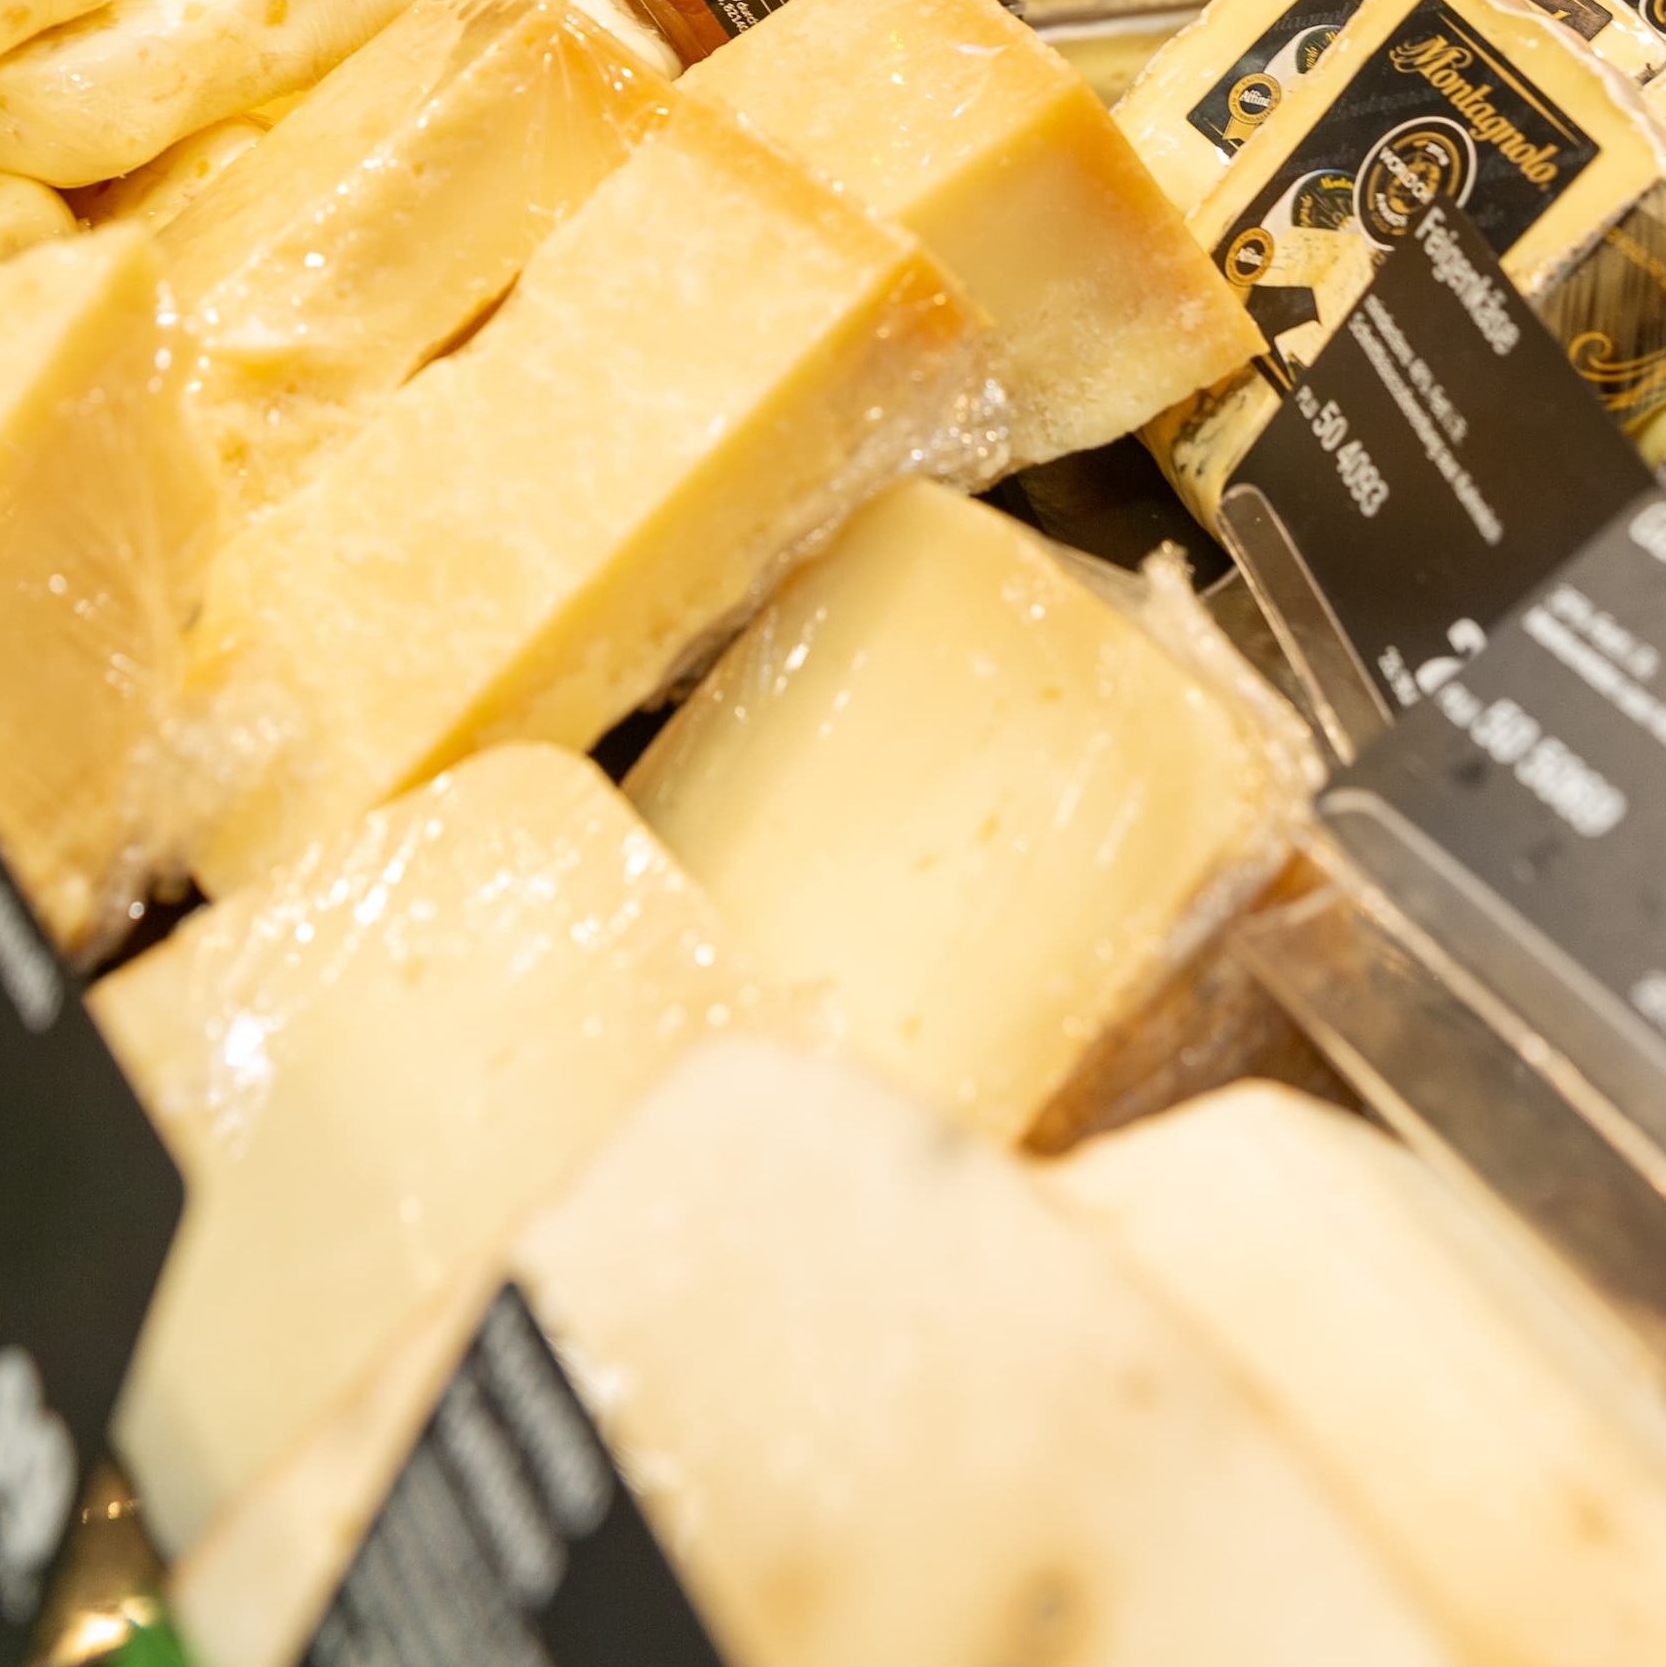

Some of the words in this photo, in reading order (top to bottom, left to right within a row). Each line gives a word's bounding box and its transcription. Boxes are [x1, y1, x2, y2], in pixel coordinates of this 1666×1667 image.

[1389, 34, 1560, 183] Montagnolo
[1414, 205, 1521, 355] Feigenkäse
[1311, 401, 1348, 451] 50
[1337, 441, 1388, 516] 4093
